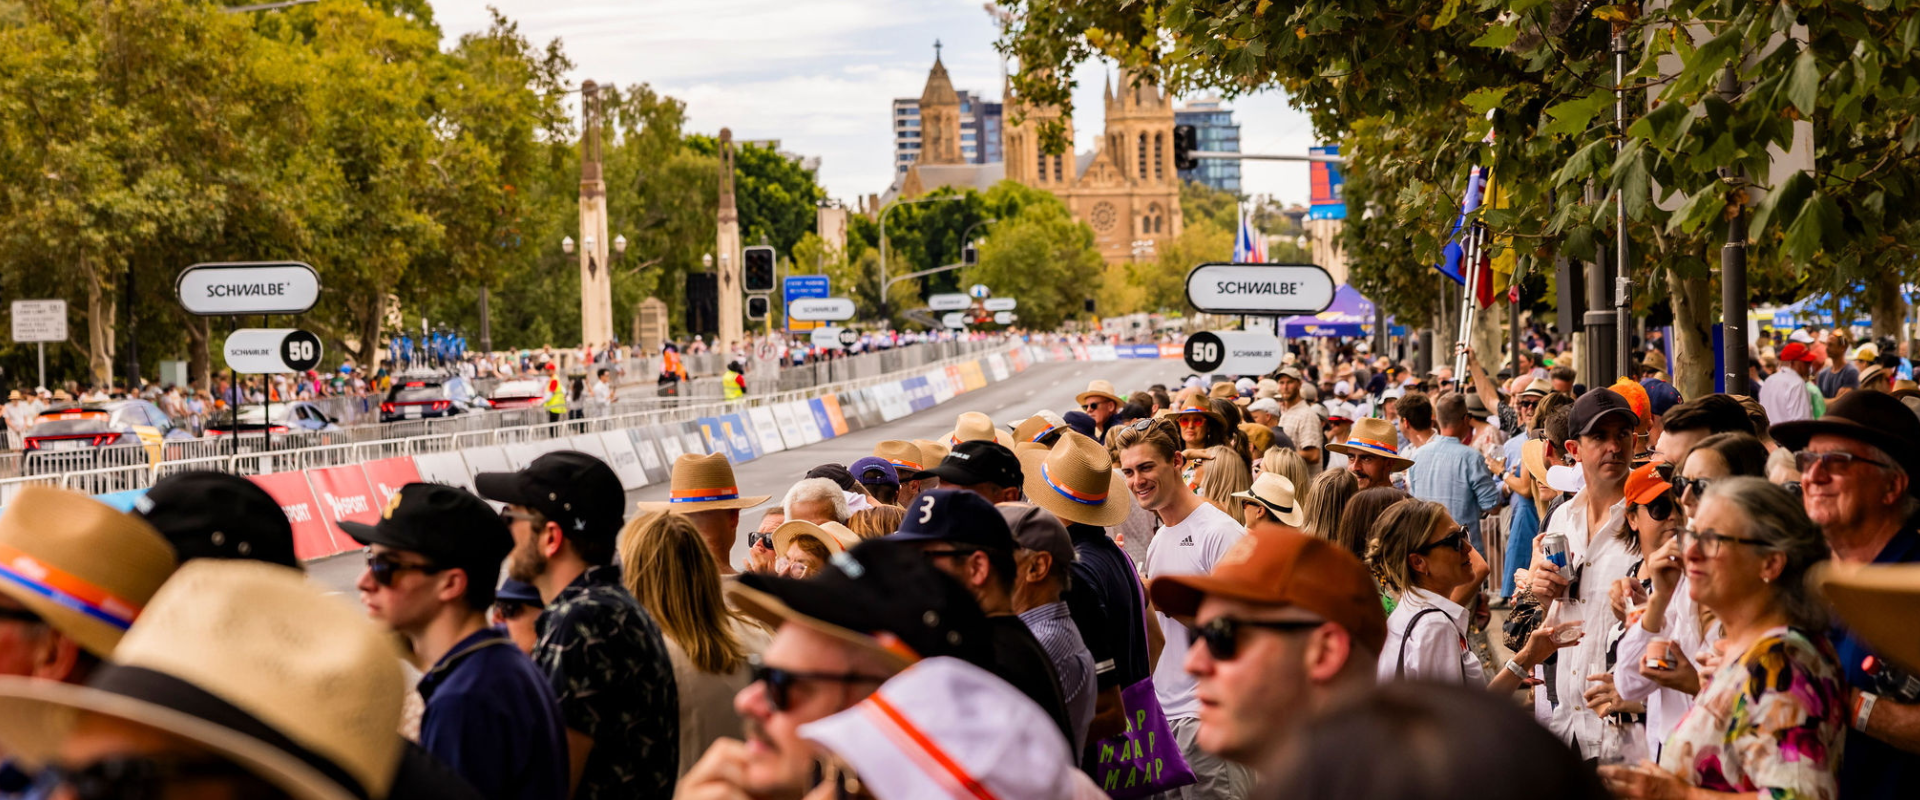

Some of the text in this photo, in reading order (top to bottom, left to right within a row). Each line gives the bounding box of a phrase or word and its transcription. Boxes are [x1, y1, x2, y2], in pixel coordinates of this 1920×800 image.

[206, 283, 285, 297] SCHWALBE
[1216, 281, 1297, 295] SCHWALBE
[231, 348, 270, 356] SCHWALBE
[289, 340, 313, 361] 50
[1192, 342, 1217, 363] 50
[1232, 350, 1273, 358] SCHWALBE
[919, 496, 935, 524] 3
[1099, 731, 1155, 763] MAAP
[1104, 758, 1163, 790] MAAP
